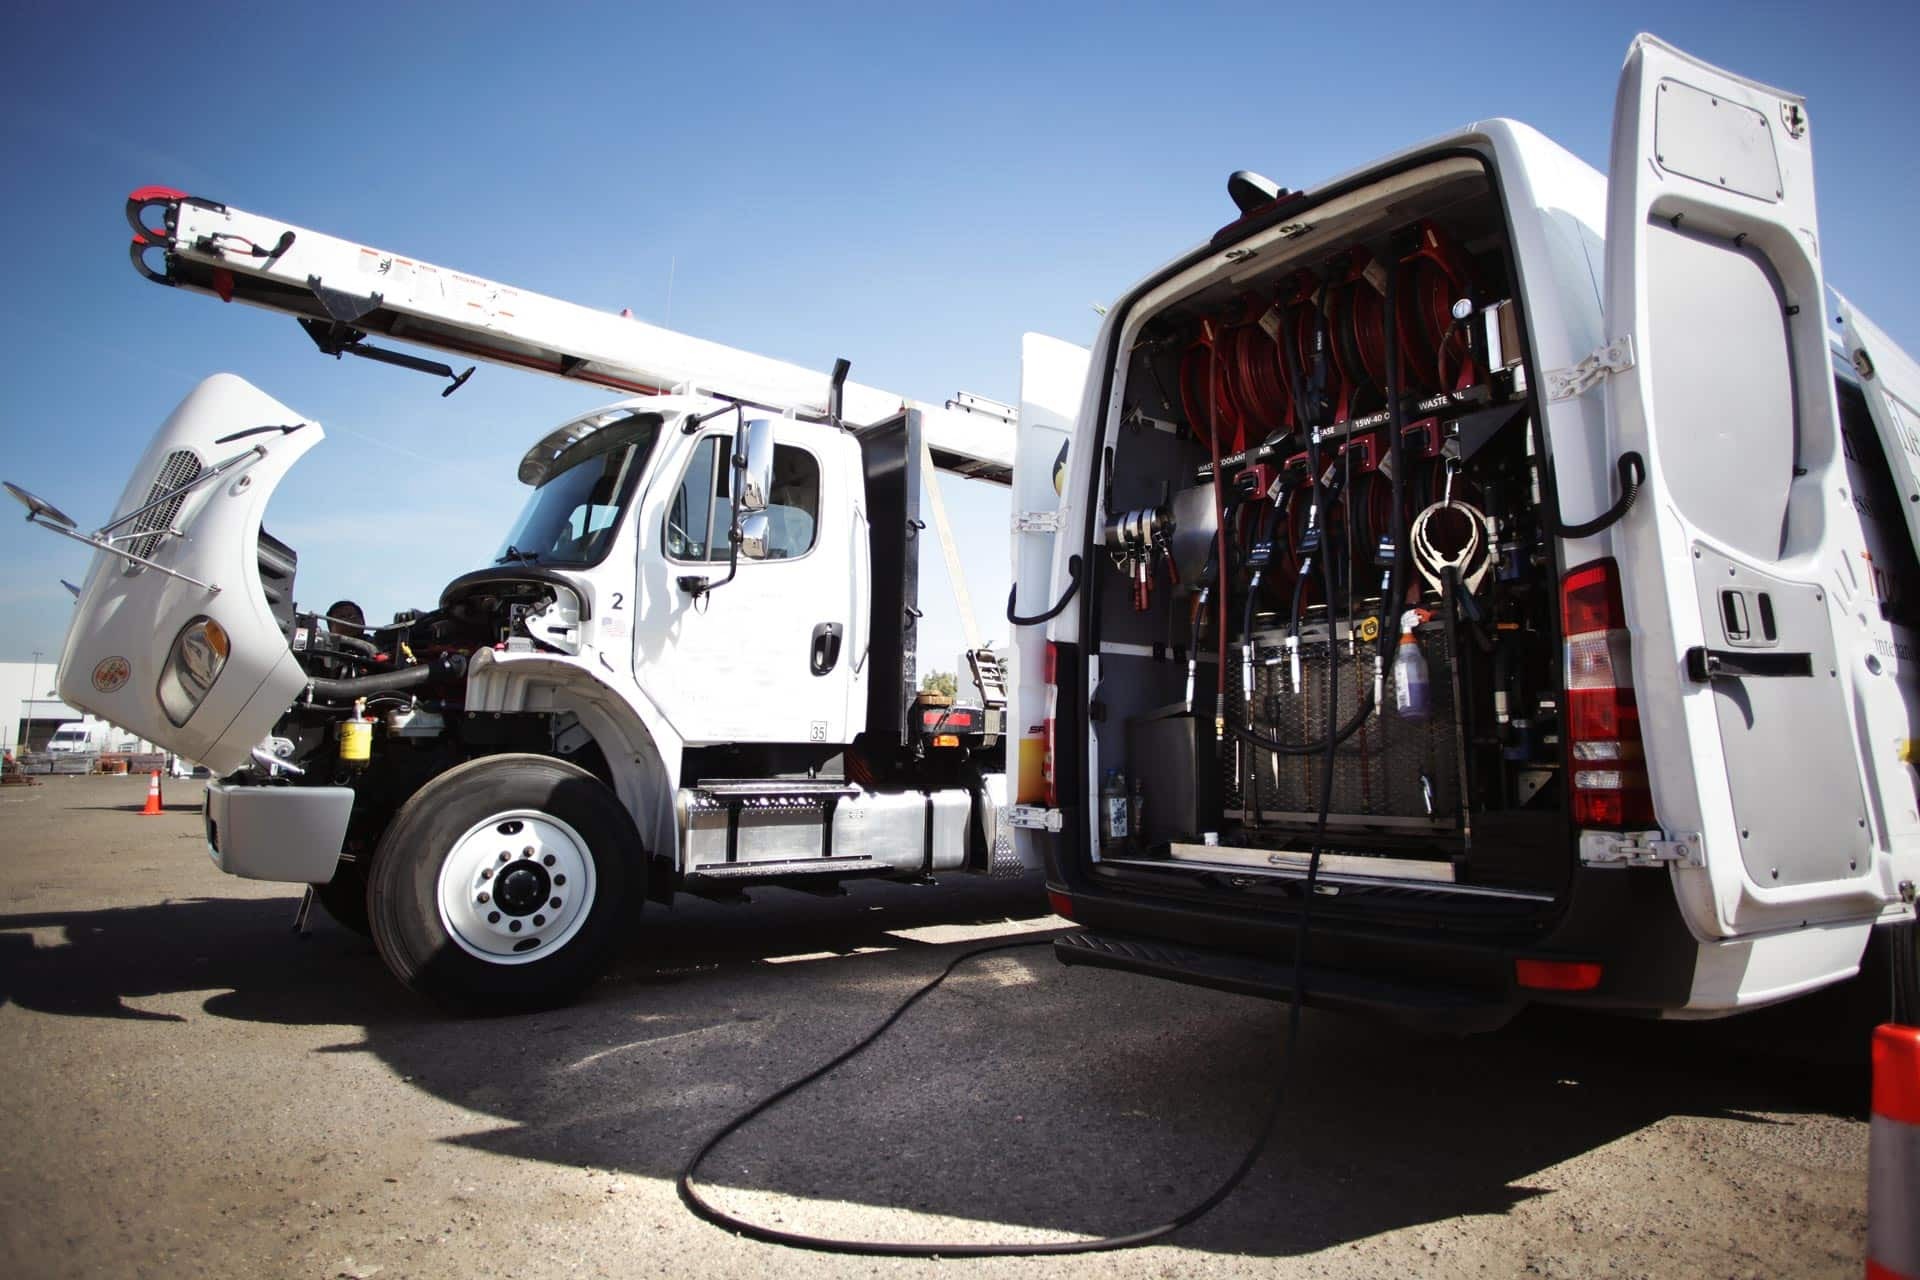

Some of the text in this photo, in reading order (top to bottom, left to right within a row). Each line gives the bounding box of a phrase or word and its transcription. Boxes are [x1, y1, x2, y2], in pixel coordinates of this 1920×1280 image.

[1418, 396, 1447, 411] WASTE
[1354, 414, 1382, 428] 15W-40
[1258, 446, 1272, 457] AIR
[1198, 463, 1214, 473] WAST
[611, 592, 624, 610] 2
[814, 726, 825, 740] 35
